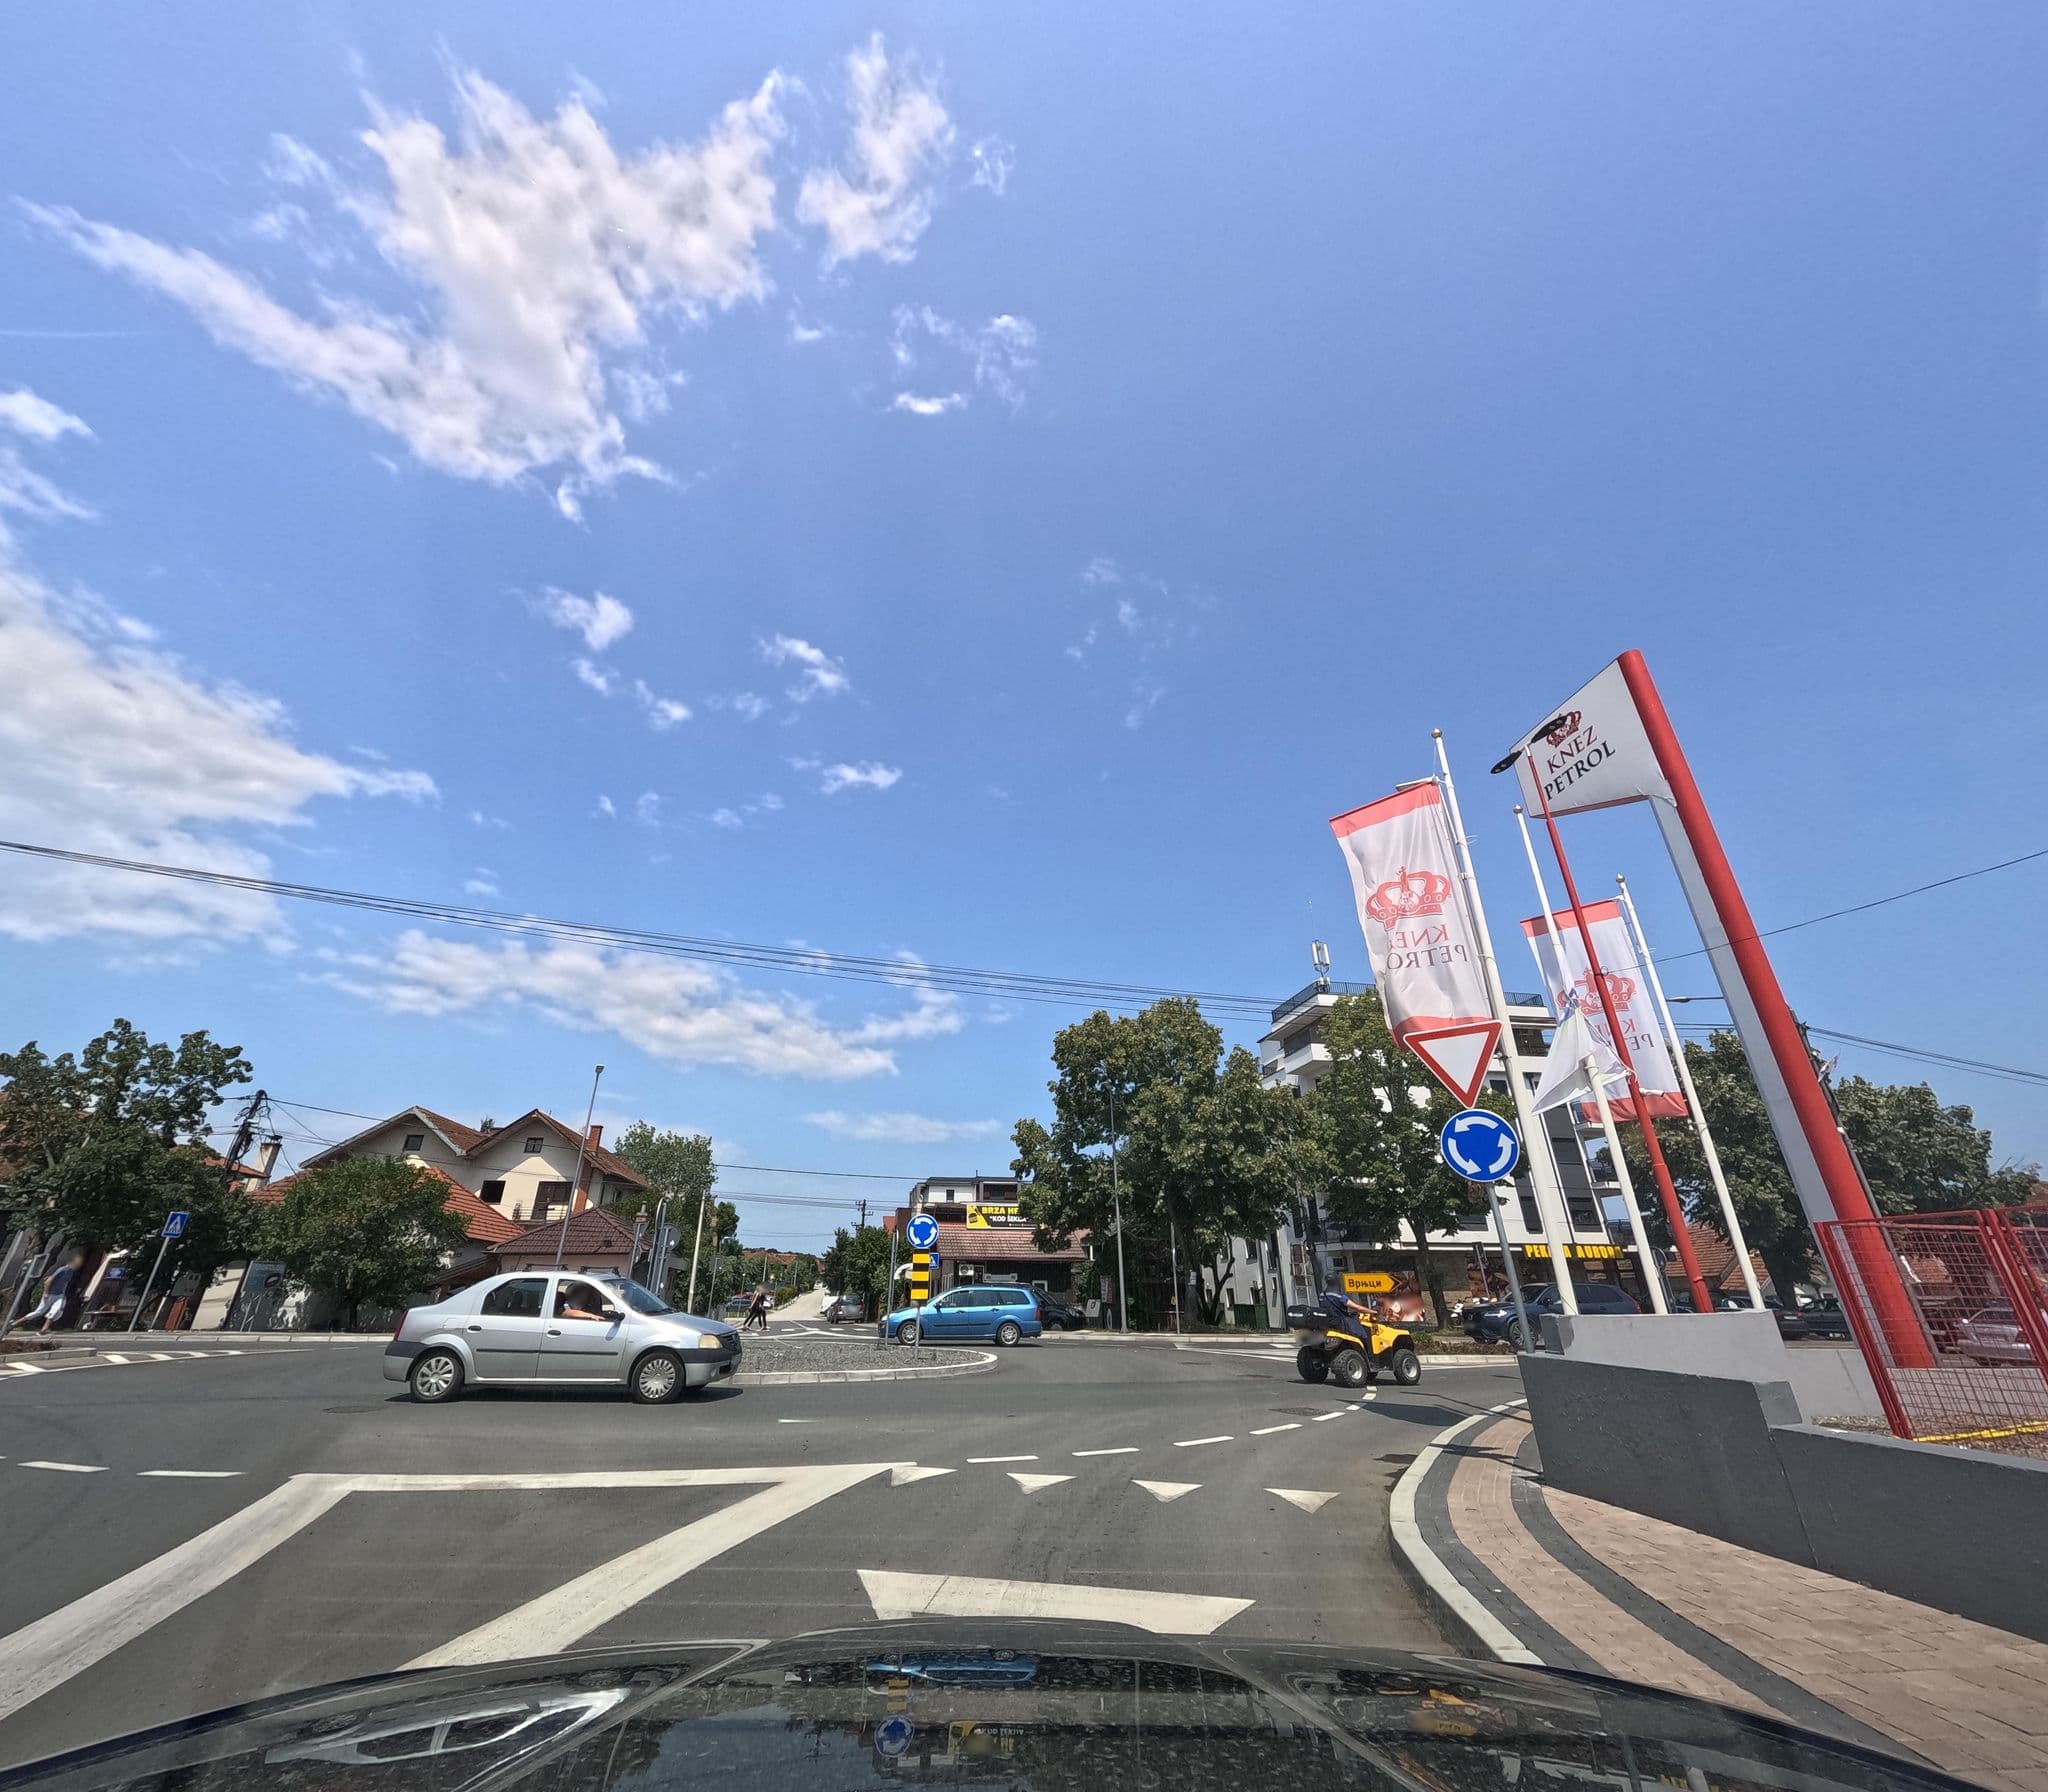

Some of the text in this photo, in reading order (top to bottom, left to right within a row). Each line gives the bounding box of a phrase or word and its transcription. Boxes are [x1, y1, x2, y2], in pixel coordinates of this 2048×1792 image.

[1547, 725, 1597, 774] KNEZ
[1544, 741, 1615, 802] PETROL
[981, 1206, 1006, 1214] BRZA
[1525, 1244, 1624, 1259] PEKA AURORA
[1348, 1278, 1383, 1290] Врњци
